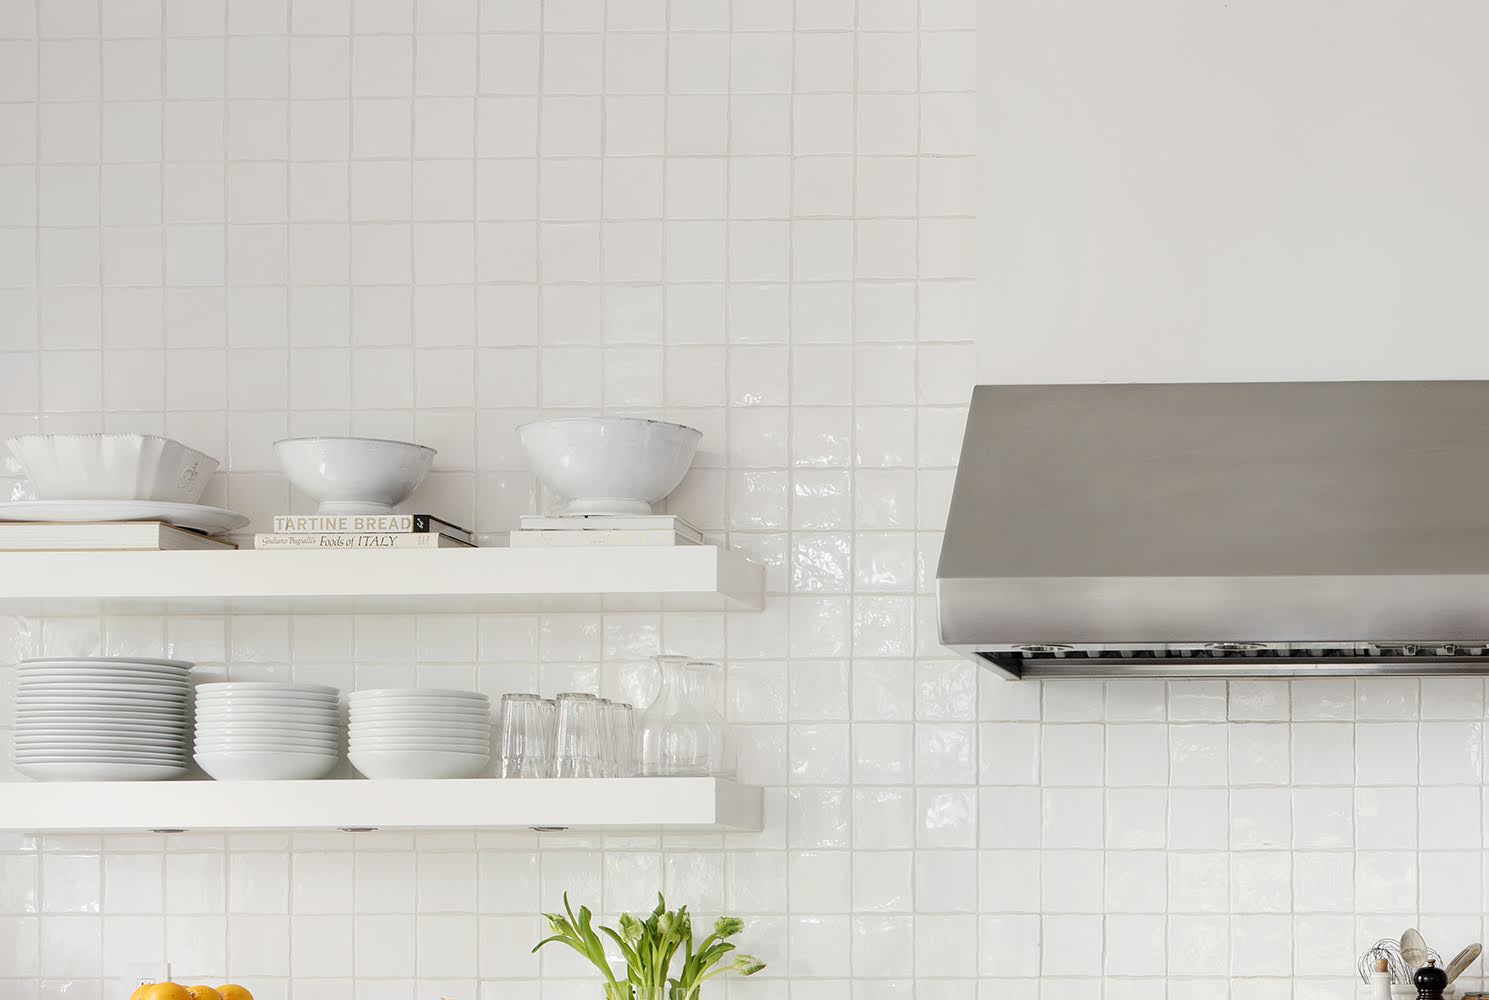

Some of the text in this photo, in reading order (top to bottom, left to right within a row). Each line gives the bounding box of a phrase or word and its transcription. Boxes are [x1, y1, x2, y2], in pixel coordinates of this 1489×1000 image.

[276, 517, 412, 530] TARTINE BREAD
[319, 535, 344, 547] Foods
[345, 536, 355, 549] of
[357, 535, 398, 547] ITALY
